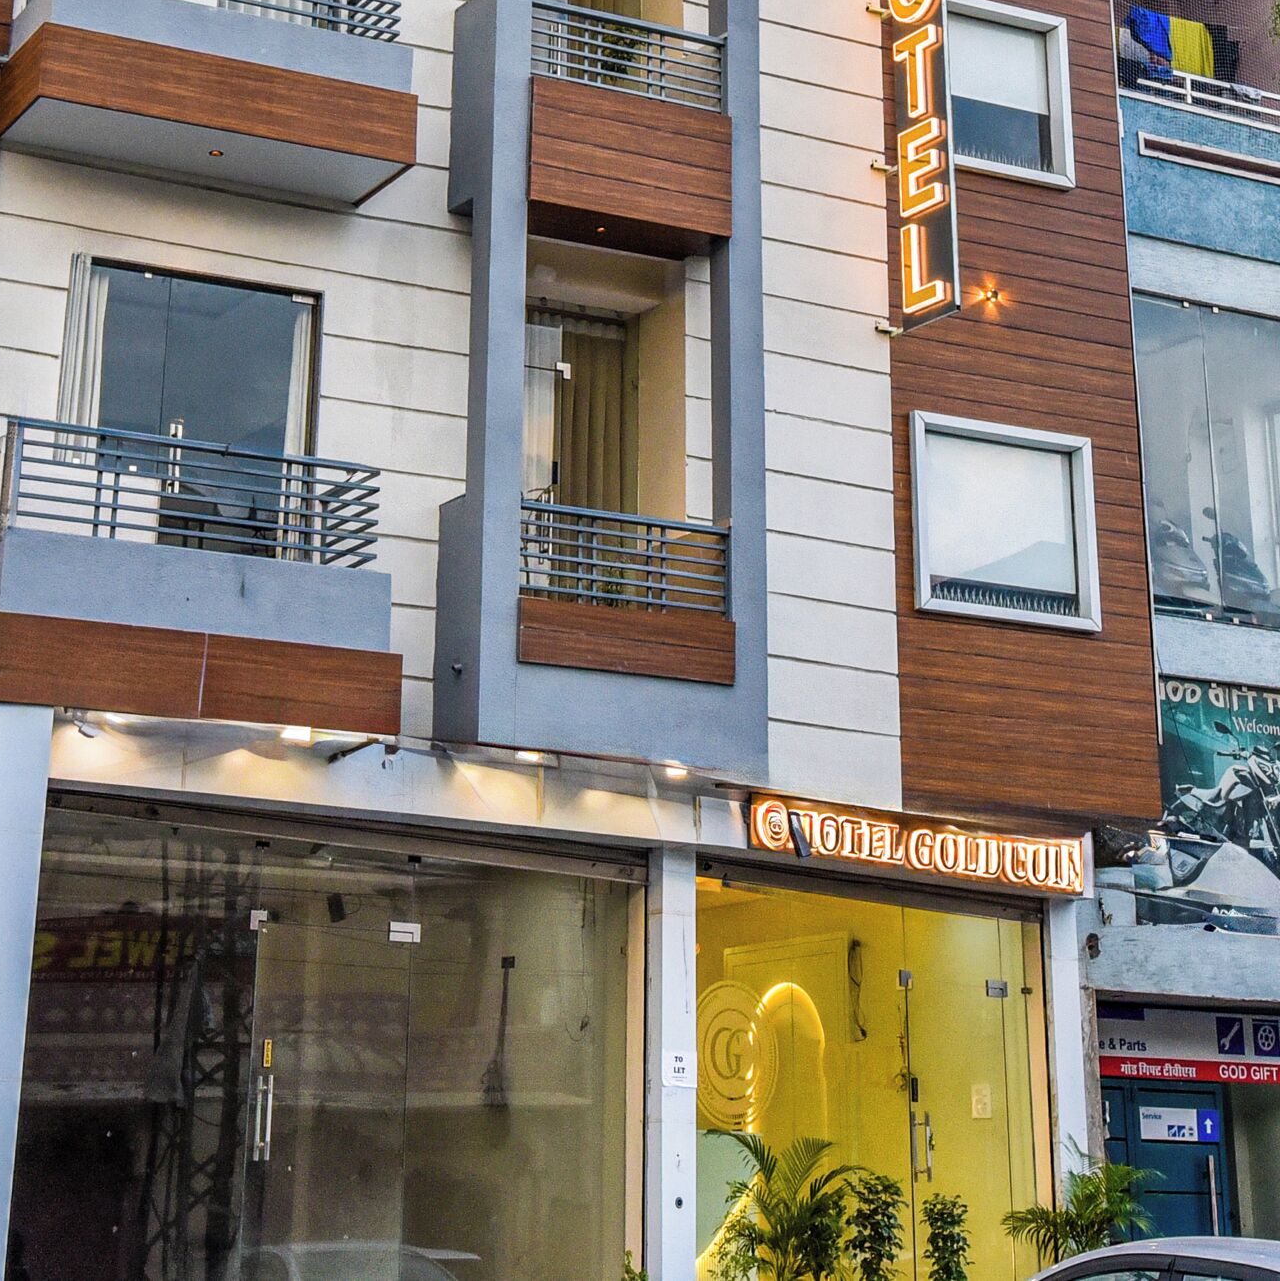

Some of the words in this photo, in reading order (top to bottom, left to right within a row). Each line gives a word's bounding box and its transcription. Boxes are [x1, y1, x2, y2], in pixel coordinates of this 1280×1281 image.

[1108, 1039, 1116, 1050] &
[1119, 1038, 1147, 1052] Parts
[674, 1055, 684, 1063] TO
[1219, 1065, 1247, 1079] GOD
[1251, 1066, 1278, 1081] GIFT
[1141, 1112, 1162, 1121] Service
